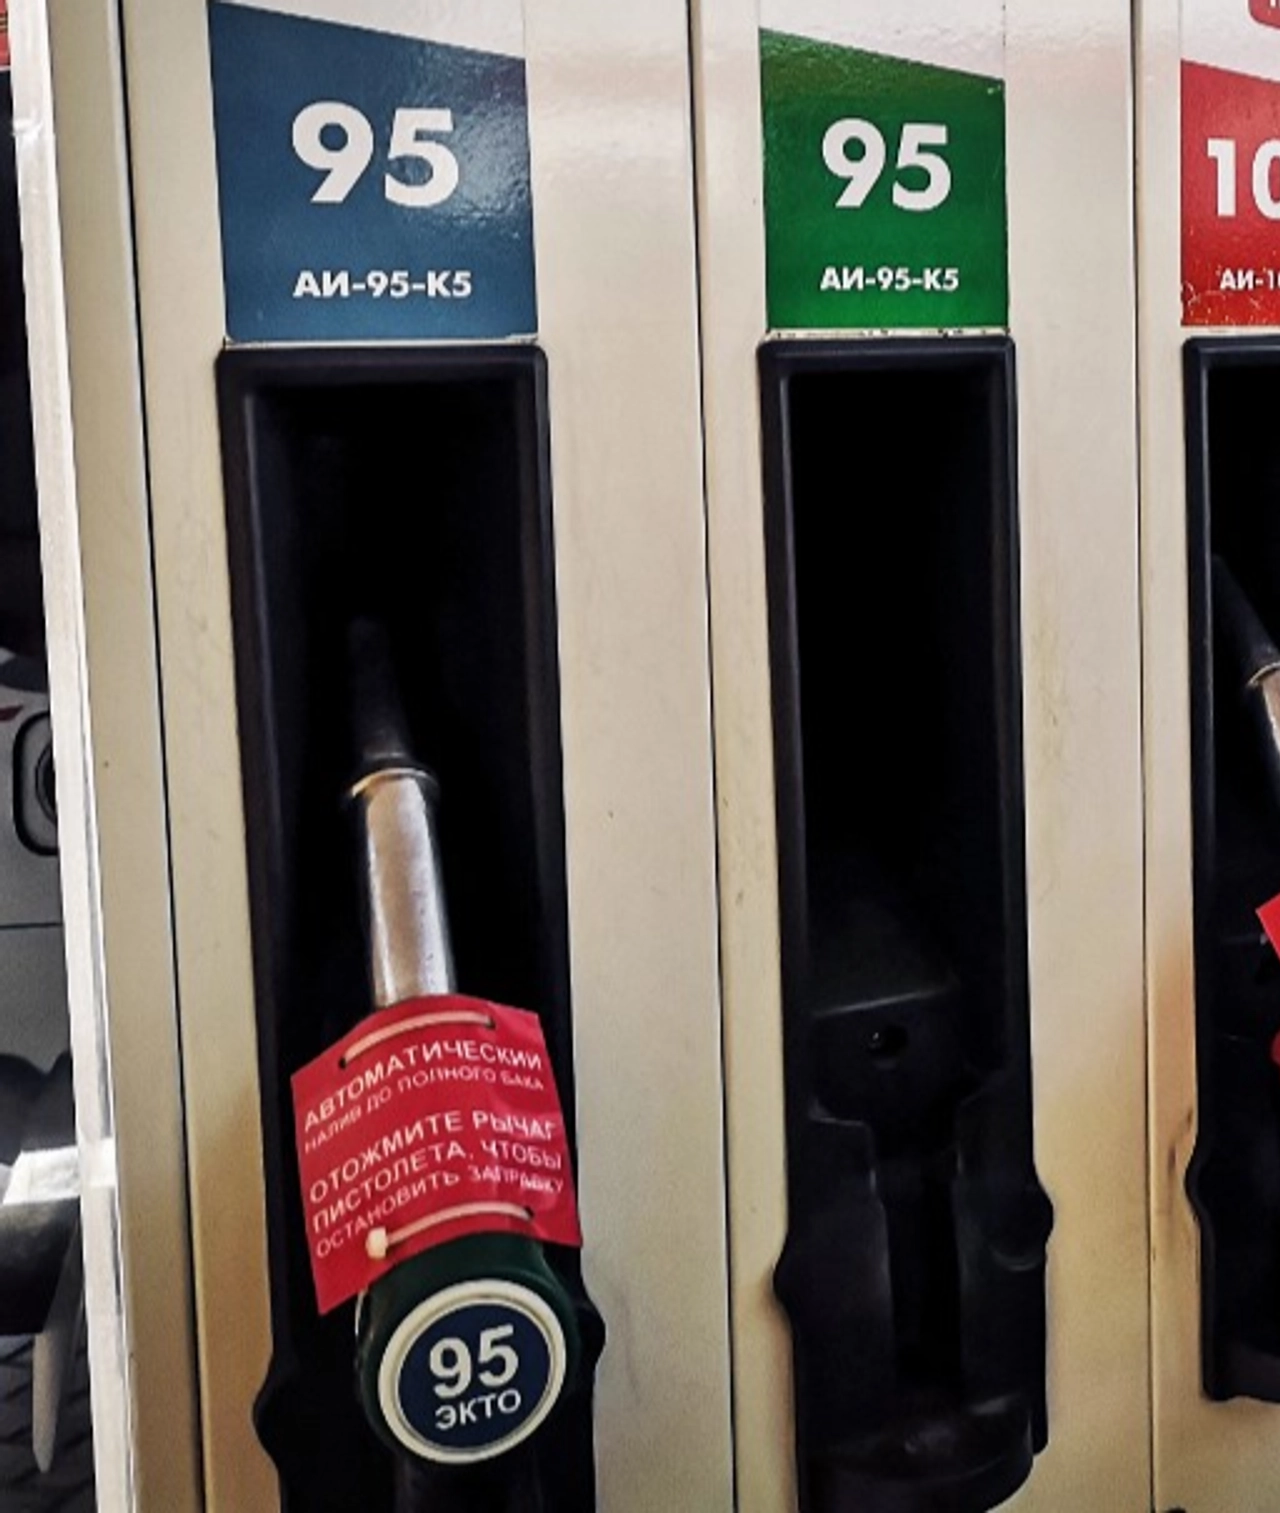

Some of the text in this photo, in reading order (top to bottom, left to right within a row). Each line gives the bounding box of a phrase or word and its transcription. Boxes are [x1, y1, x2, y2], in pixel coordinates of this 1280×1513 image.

[292, 100, 459, 208] 95
[821, 117, 952, 212] 95
[292, 269, 472, 299] АИ-95-К5
[819, 265, 960, 292] АИ-95-К5
[397, 1065, 497, 1094] ПОЛНОГО
[309, 1108, 557, 1204] ОТОЖМИТЕ РЫЧАГ
[479, 1139, 563, 1171] ЧТОБЫ
[316, 1170, 461, 1259] ОСТАНОВИТЬ
[429, 1323, 520, 1400] 95
[435, 1388, 522, 1431] ЭКТО
